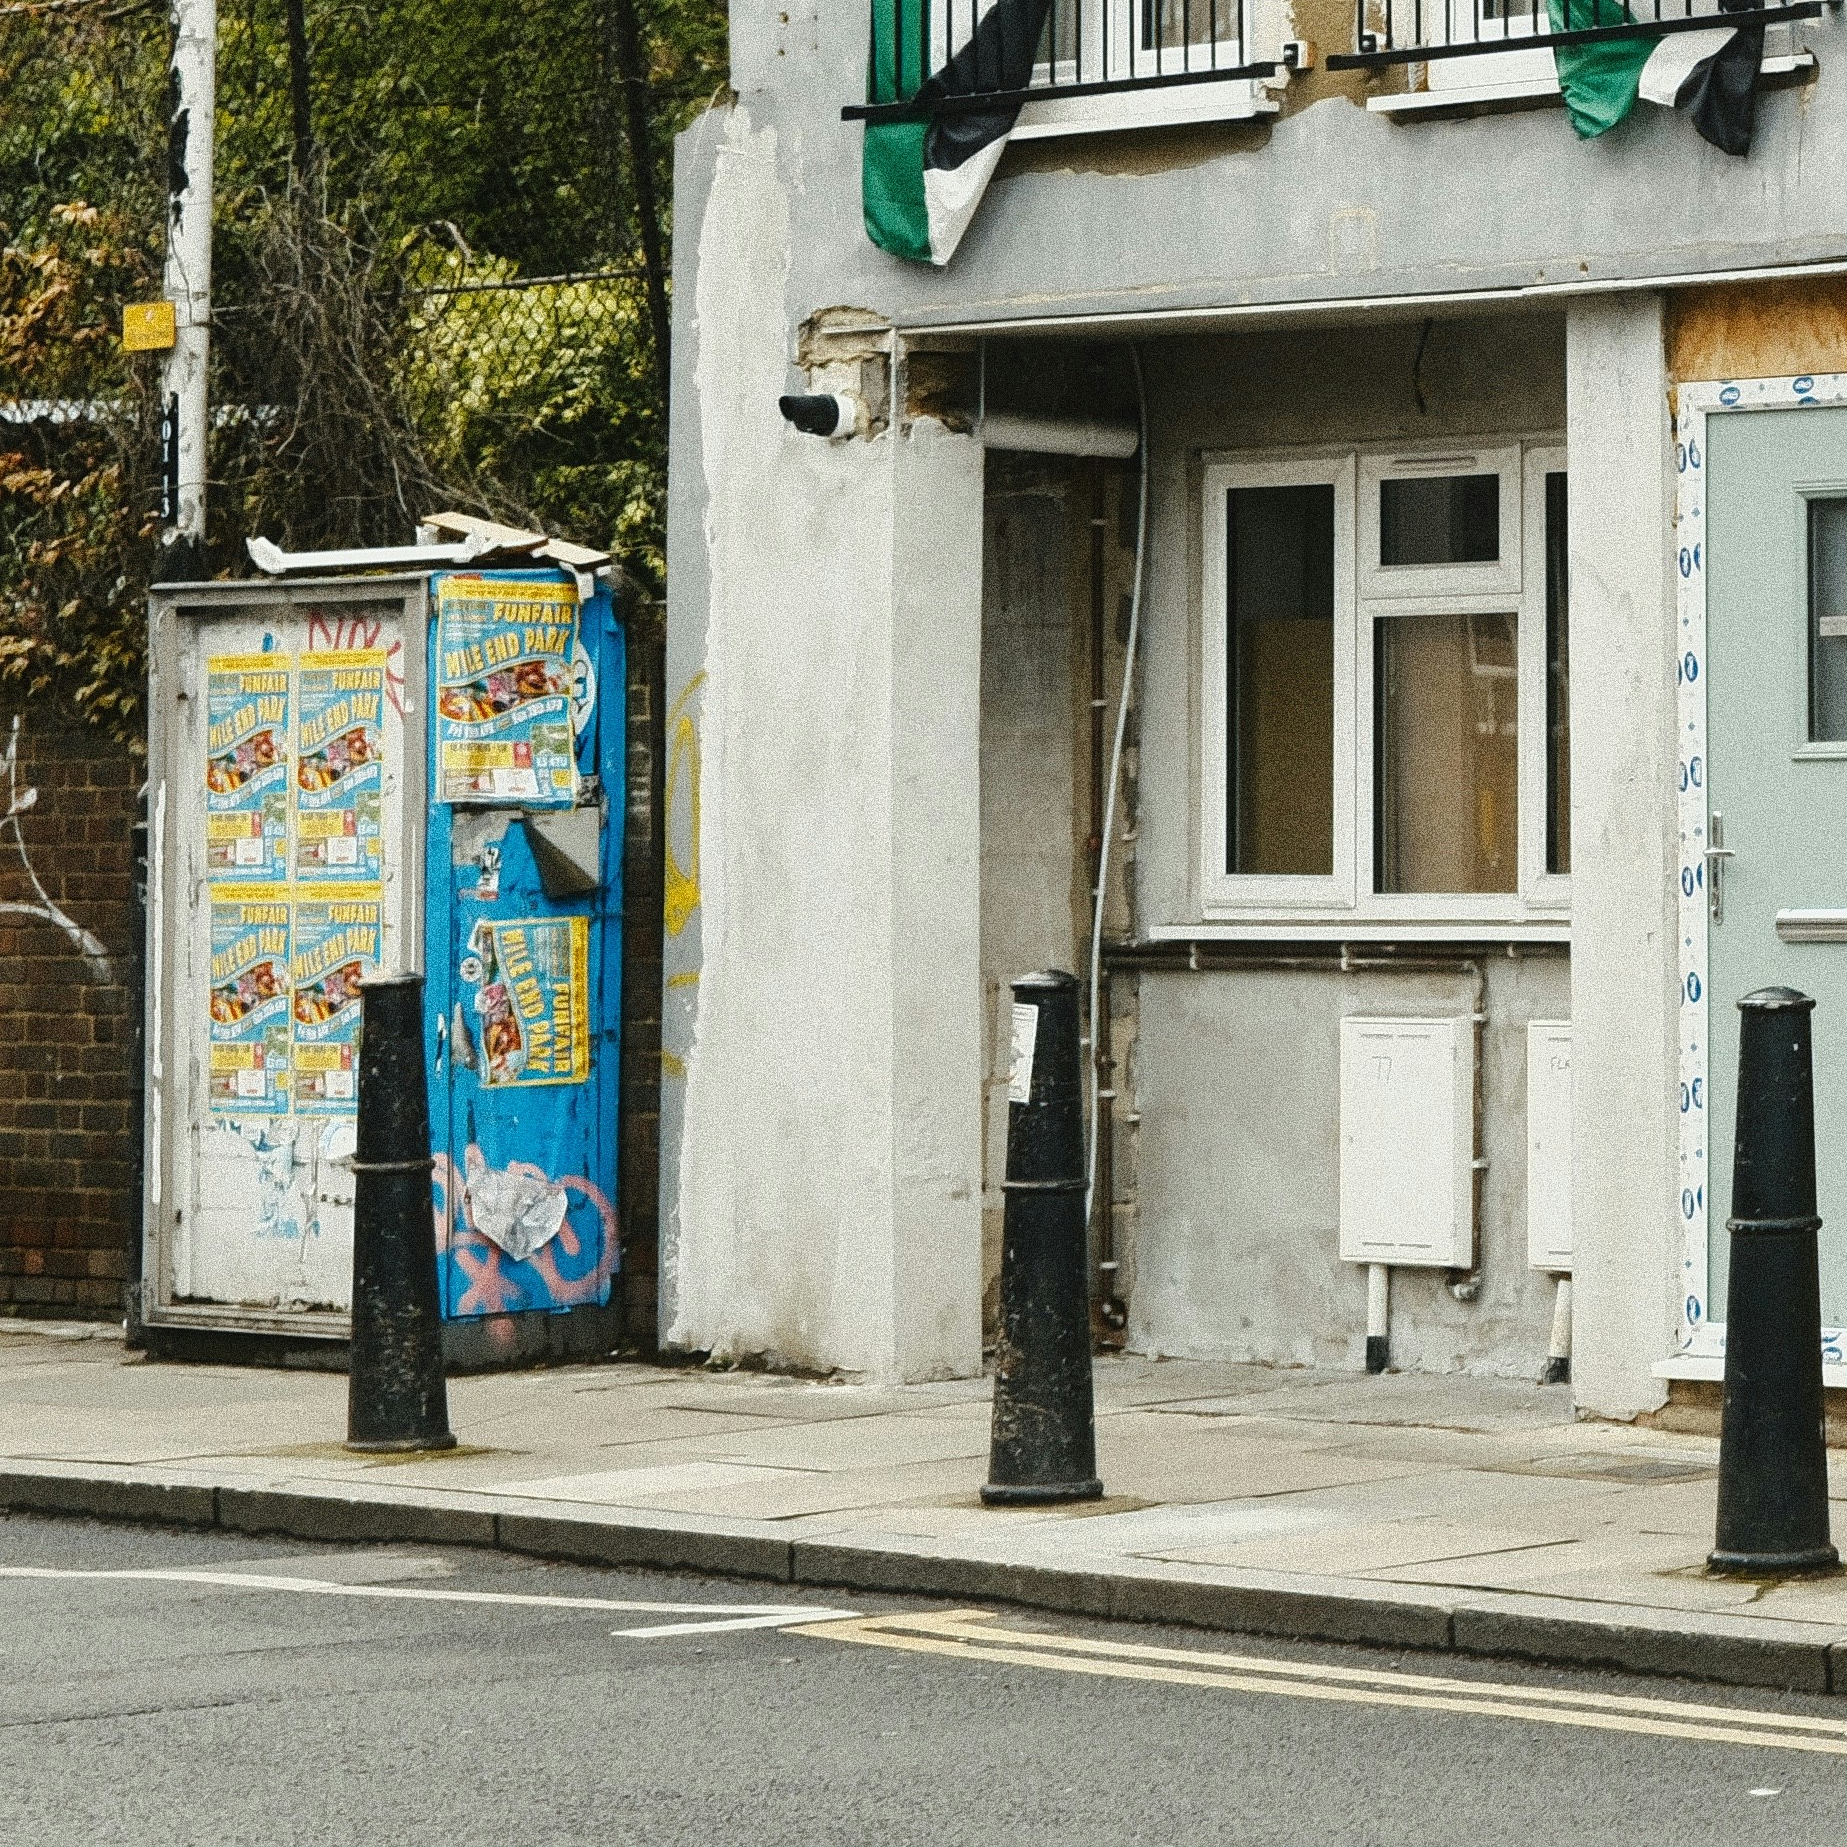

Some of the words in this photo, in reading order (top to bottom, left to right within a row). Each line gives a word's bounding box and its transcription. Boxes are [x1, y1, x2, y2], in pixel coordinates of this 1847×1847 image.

[493, 602, 573, 624] FUNFAIR
[445, 645, 484, 679] MILE
[484, 630, 520, 666] END
[524, 626, 570, 656] PARK
